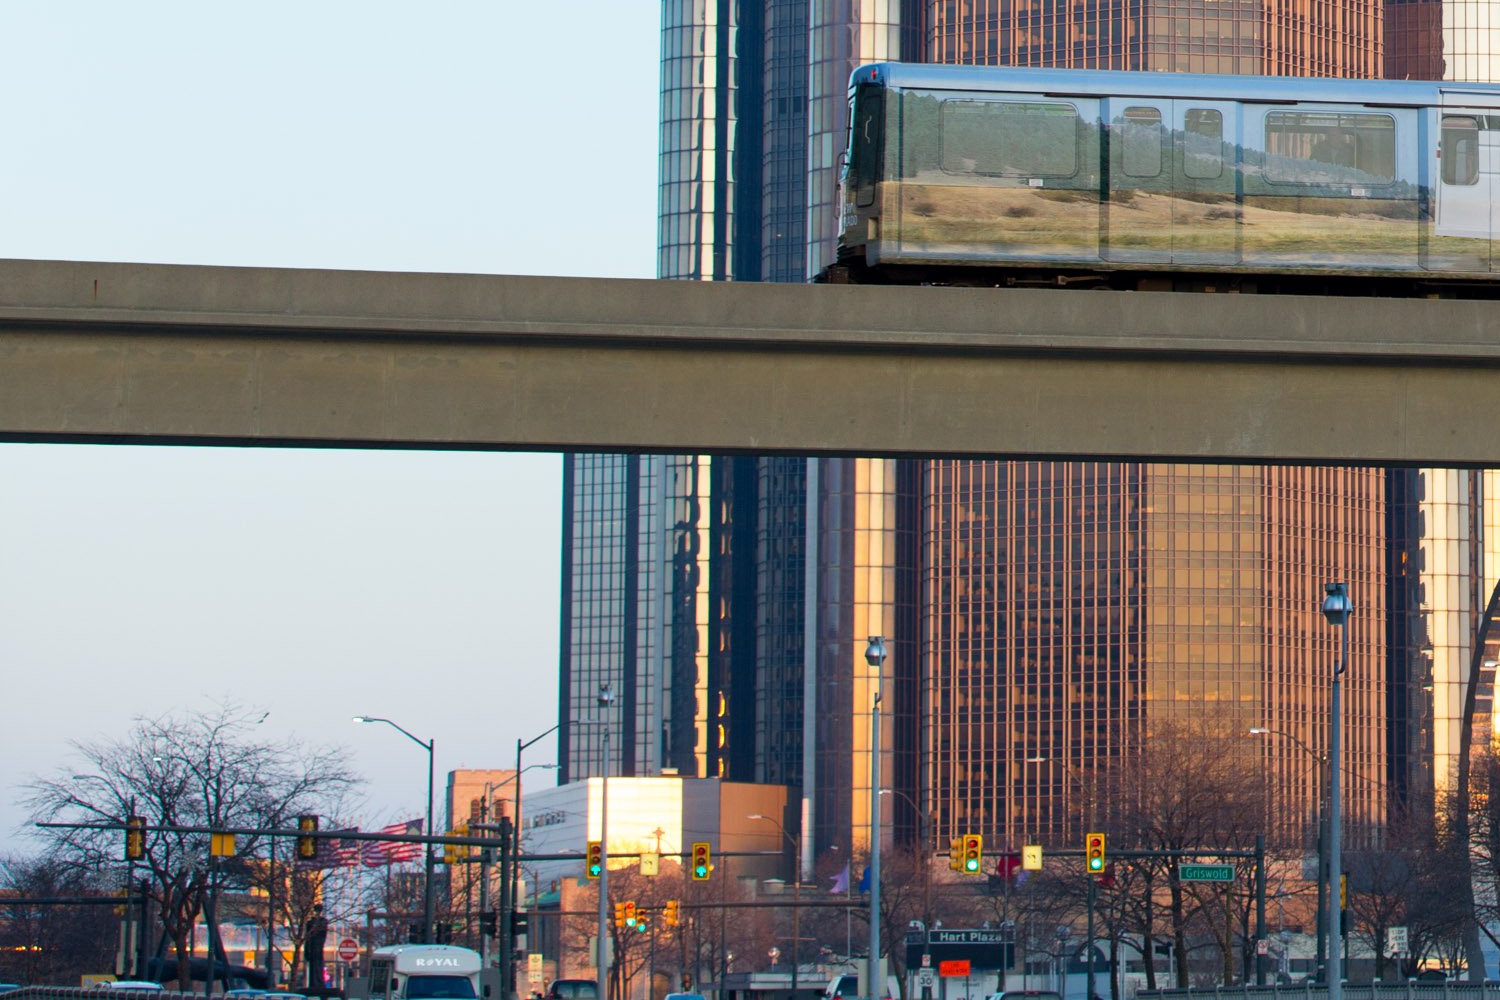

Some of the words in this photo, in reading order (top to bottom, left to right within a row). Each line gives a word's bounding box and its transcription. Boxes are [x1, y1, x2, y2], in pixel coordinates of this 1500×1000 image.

[1185, 868, 1229, 879] Griswold
[940, 932, 966, 942] Hart
[969, 932, 1002, 942] Plaza
[415, 958, 461, 967] ROYAL
[919, 977, 932, 986] 30
